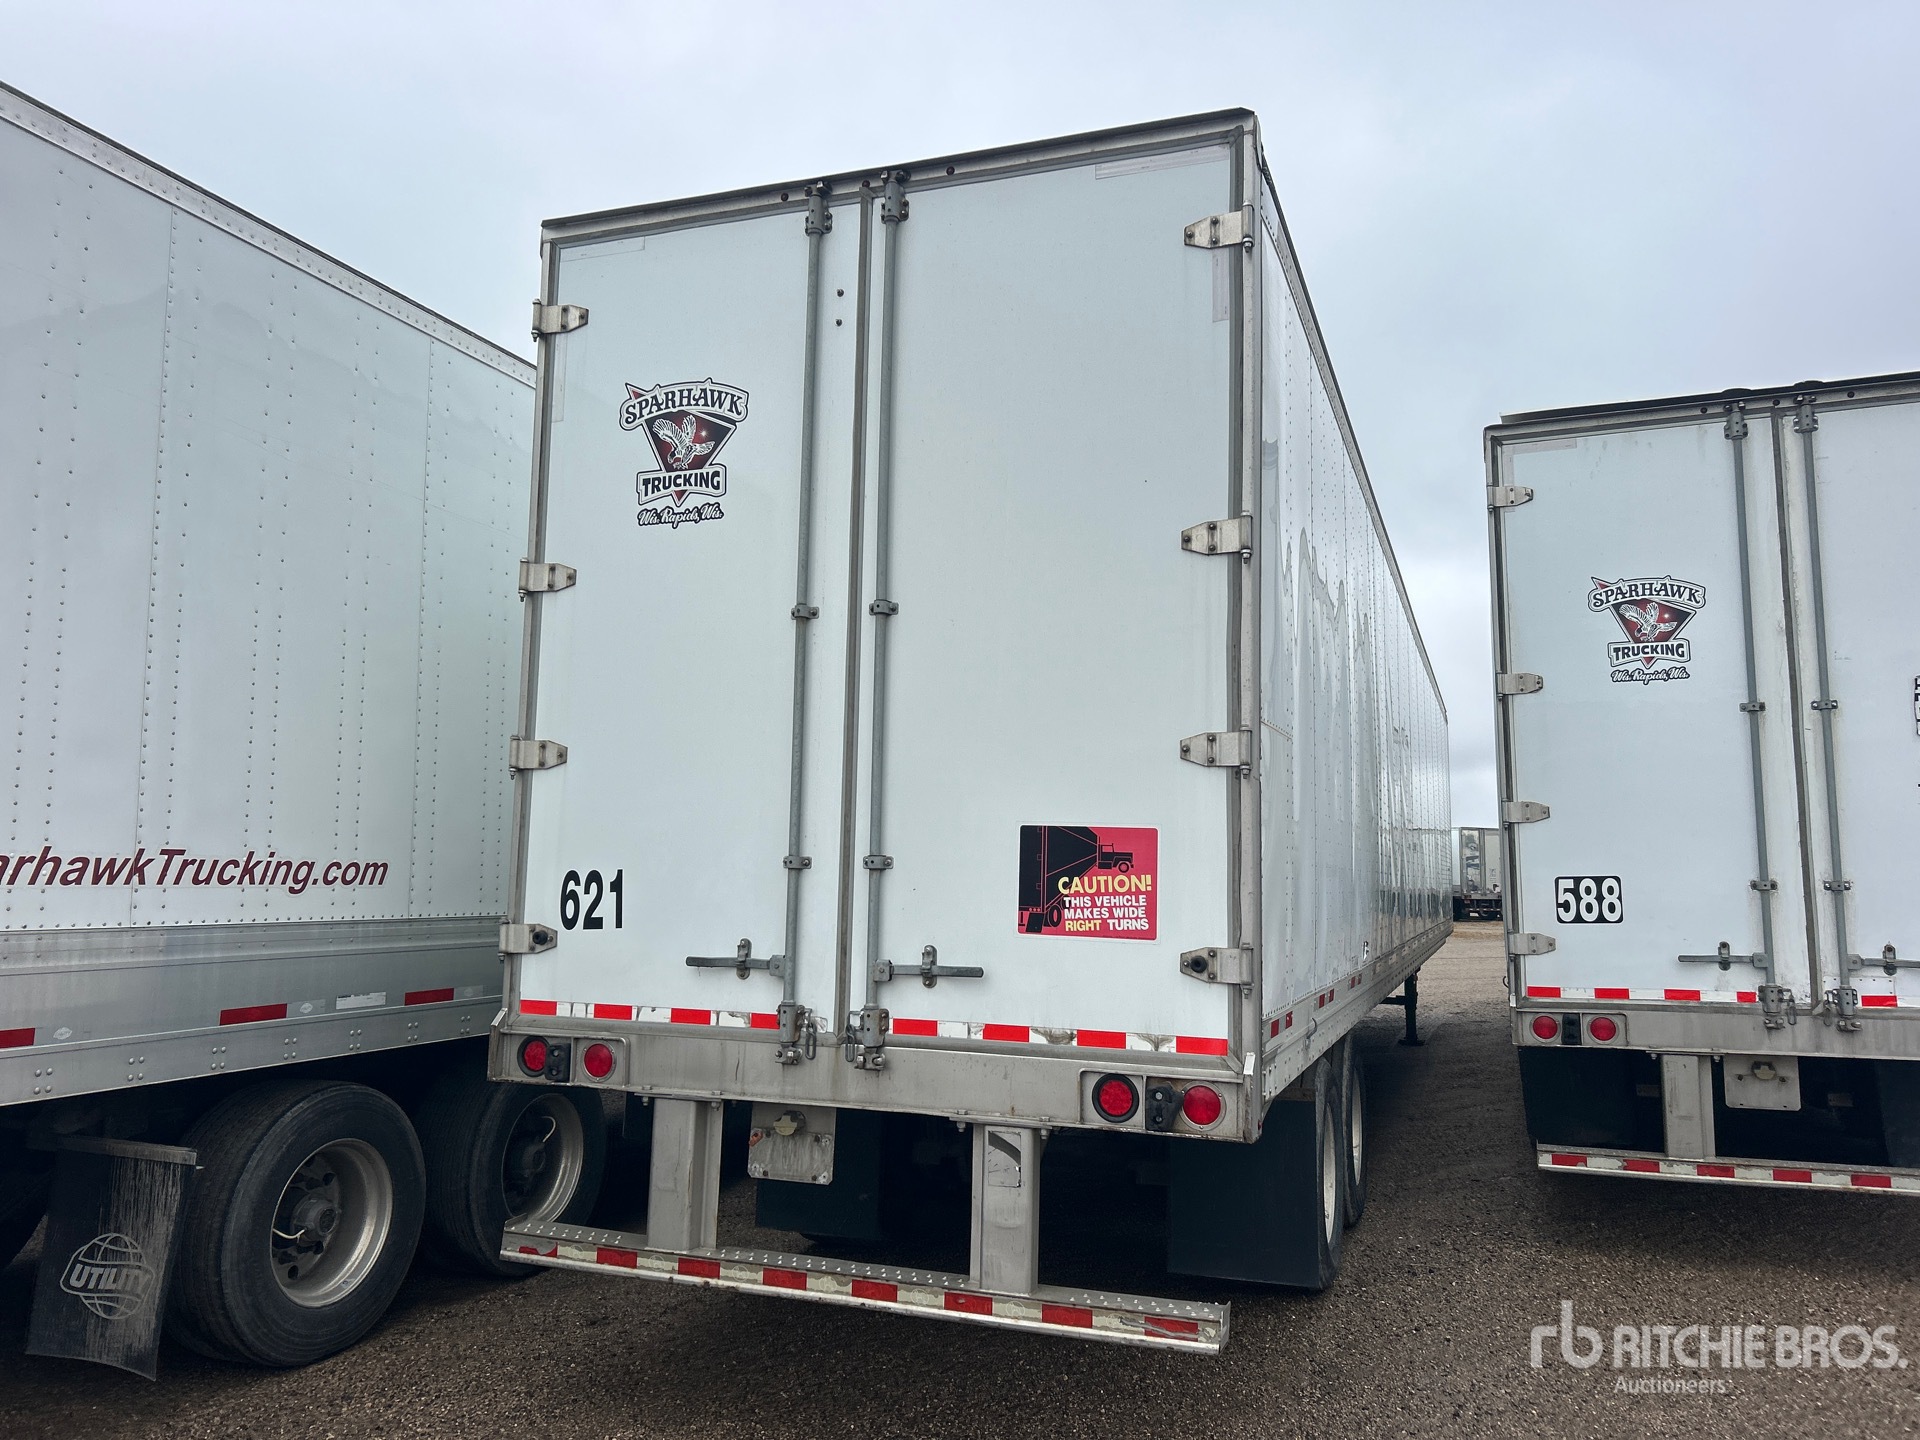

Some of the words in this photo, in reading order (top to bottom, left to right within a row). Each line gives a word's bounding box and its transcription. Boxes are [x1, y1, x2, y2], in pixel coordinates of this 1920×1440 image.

[625, 387, 742, 424] SPARHAWK
[642, 470, 720, 496] TRUCKING
[1593, 582, 1700, 607] SPARHAWK
[1613, 643, 1685, 661] TRUCKING
[1058, 874, 1152, 894] CAUTION!
[560, 869, 623, 930] 621
[1063, 897, 1092, 908] THIS
[1094, 895, 1147, 907] VEHICLE
[1557, 878, 1621, 922] 588
[1064, 908, 1110, 920] MAKES
[1113, 907, 1147, 918] WIDE
[1065, 919, 1102, 932] RIGHT
[1107, 919, 1149, 931] TURNS
